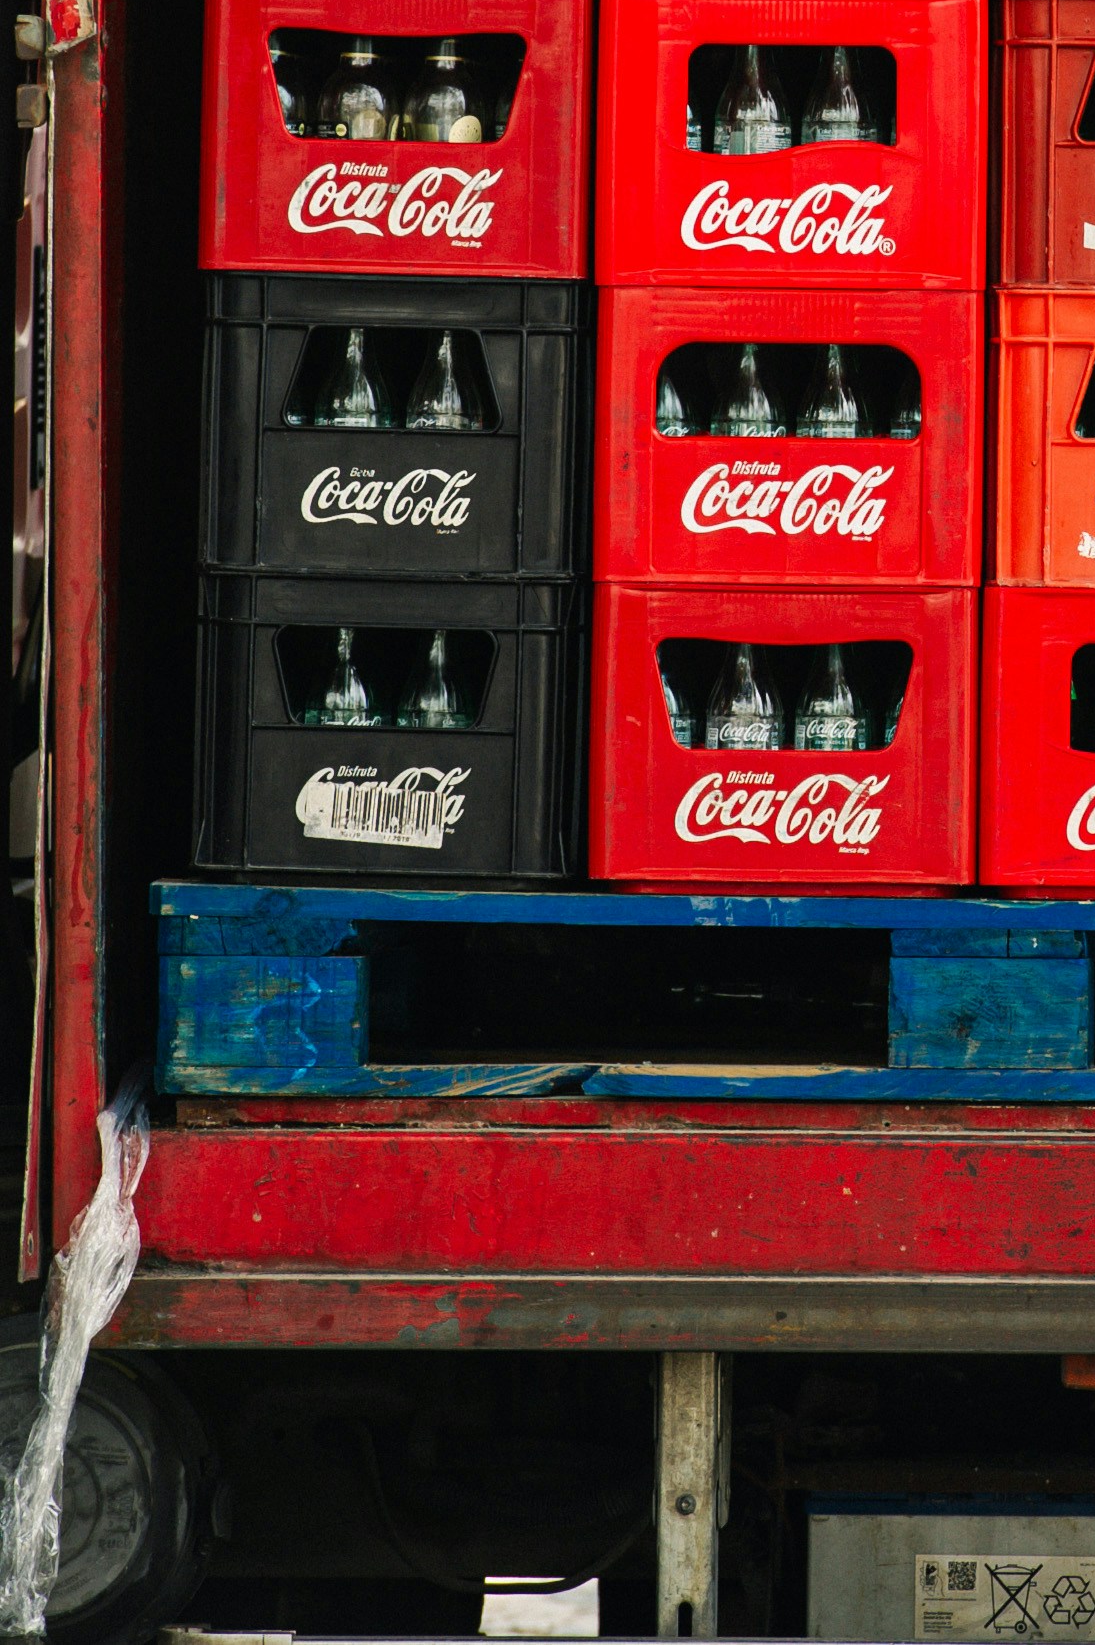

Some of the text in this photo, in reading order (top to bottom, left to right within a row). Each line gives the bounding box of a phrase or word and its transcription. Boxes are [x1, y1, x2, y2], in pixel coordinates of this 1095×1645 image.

[340, 161, 388, 177] Disfruta
[287, 163, 503, 238] Coca-Cola
[732, 460, 780, 475] Disfruta
[301, 466, 477, 526] Coca-Cola
[681, 463, 894, 535] Coca-Cola
[720, 722, 772, 743] Coca-Cola
[806, 719, 858, 739] Coca-Cola
[337, 766, 377, 778] Disfruta
[726, 770, 775, 785] Disfruta
[674, 772, 890, 844] Coca-Cola
